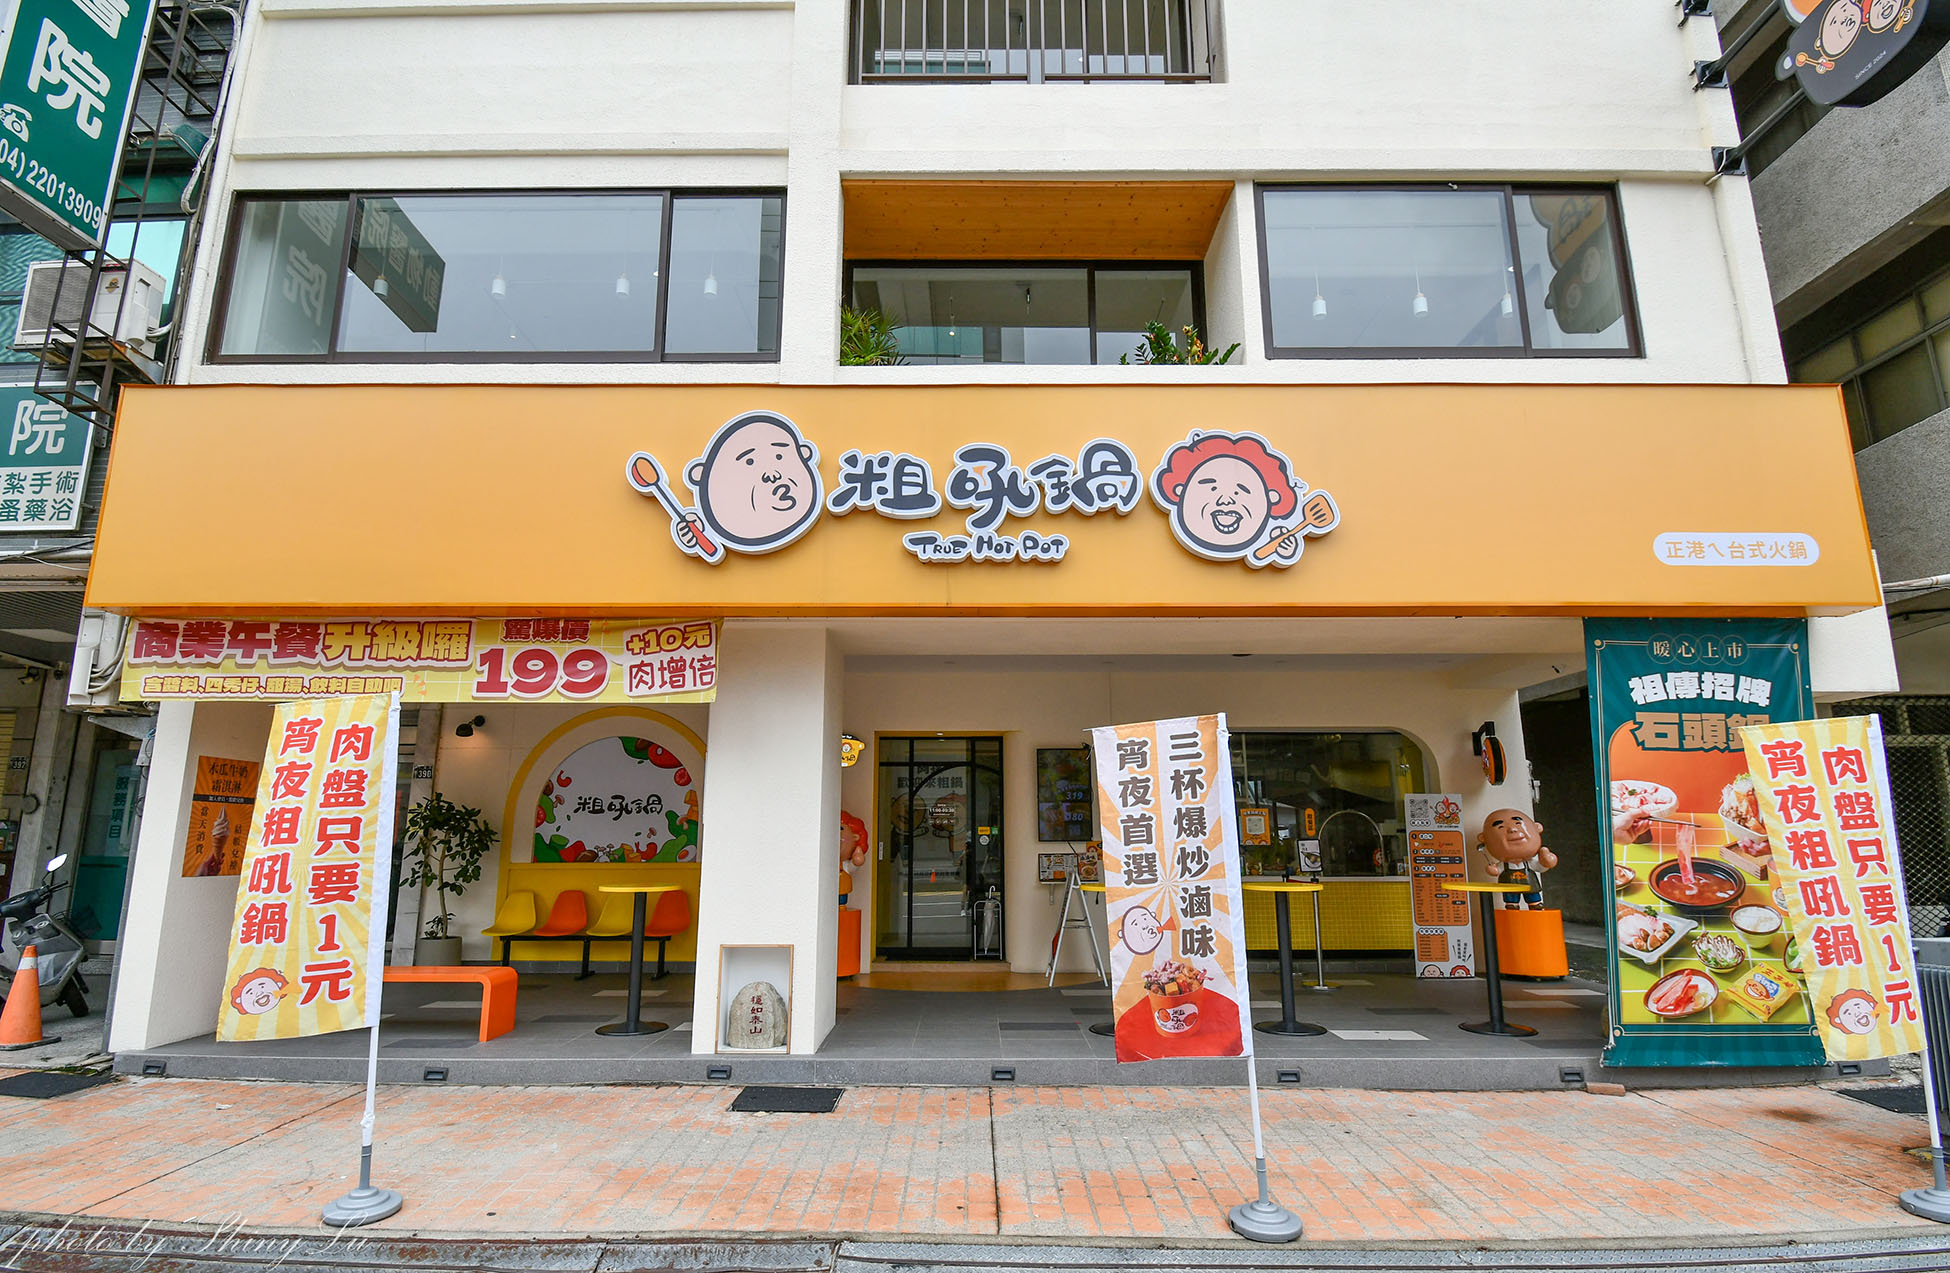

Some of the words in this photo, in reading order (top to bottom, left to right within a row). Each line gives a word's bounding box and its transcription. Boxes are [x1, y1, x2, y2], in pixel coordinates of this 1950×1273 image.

[8, 399, 70, 456] 院
[0, 470, 80, 495] 紮手術
[831, 442, 1138, 530] 粗吼鍋
[474, 647, 609, 695] 199
[627, 653, 717, 693] 肉增倍
[1652, 640, 1744, 660] 暖心上市
[1627, 670, 1773, 708] 祖傳招牌
[239, 716, 324, 945] 宵夜粗吼鍋
[573, 794, 664, 821] 粗吼鍋
[1115, 739, 1159, 887] 宵夜首選
[300, 722, 375, 1006] 肉盤只要1元
[1168, 730, 1216, 959] 三杯爆炒滷味
[1759, 740, 1864, 968] 宵夜粗吼鍋
[1821, 745, 1918, 1025] 肉盤只要1元
